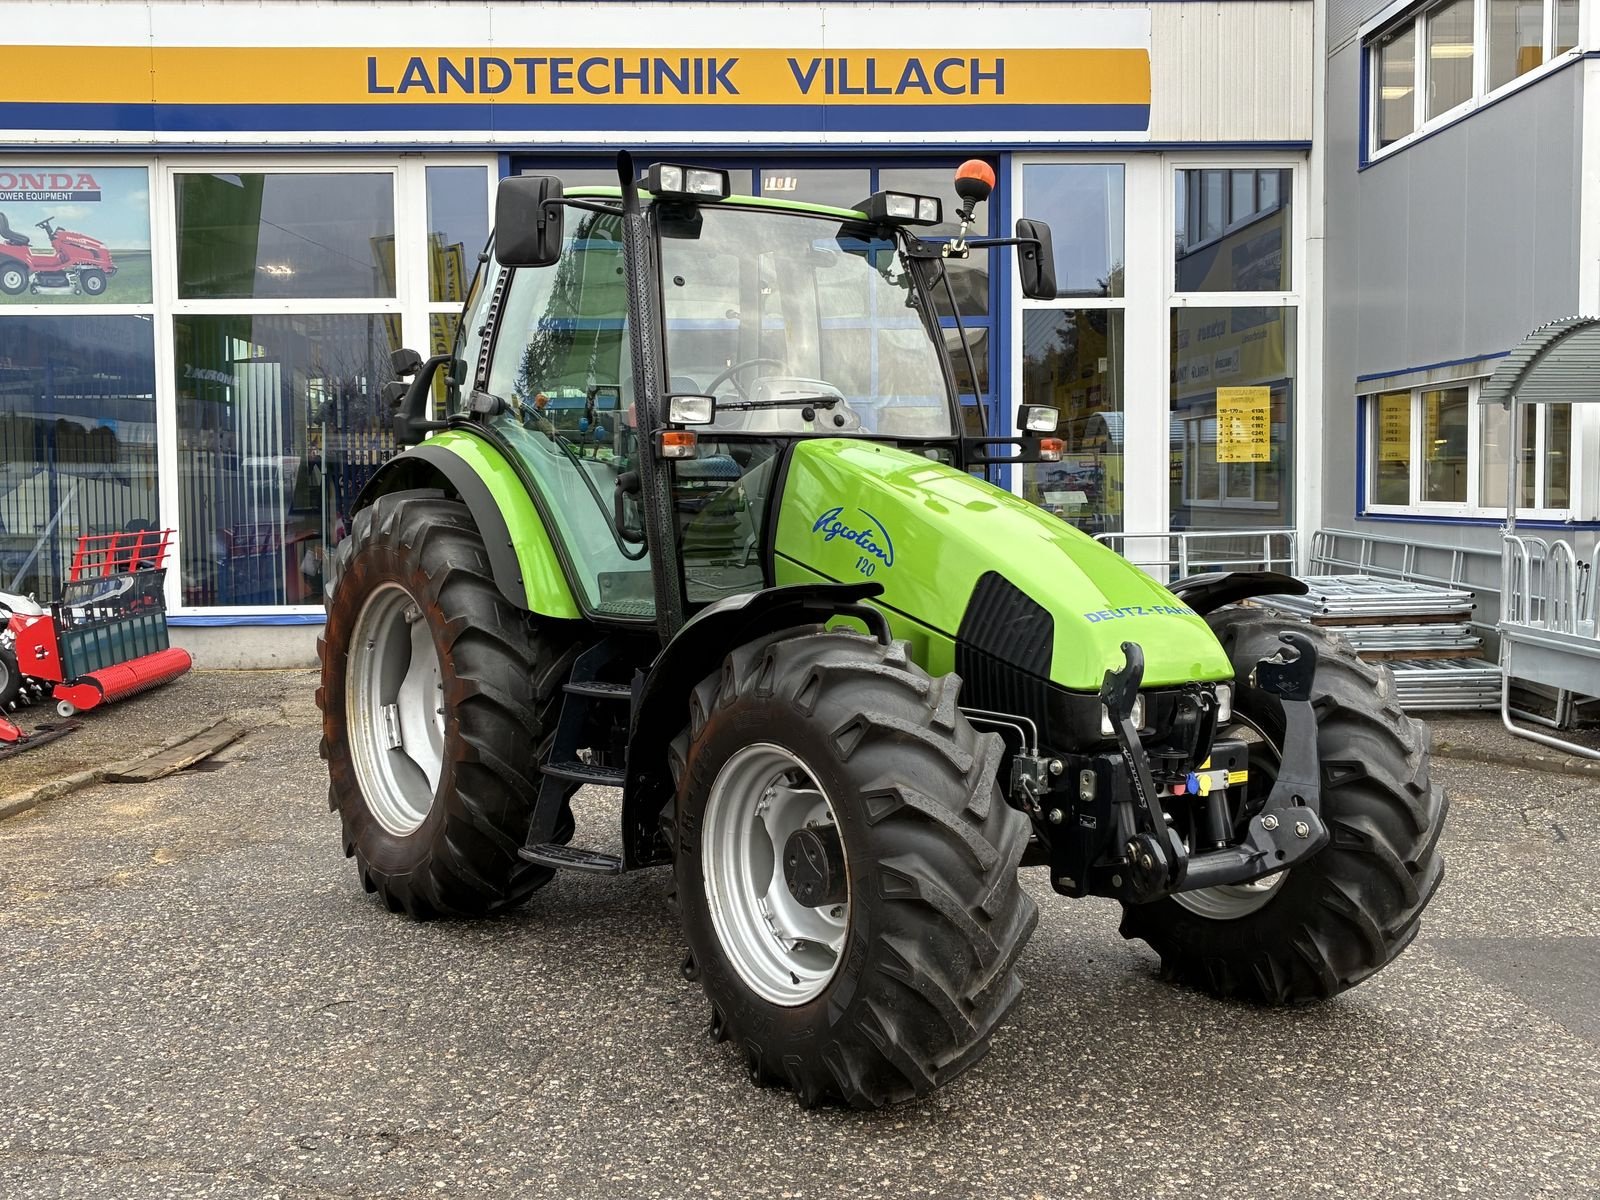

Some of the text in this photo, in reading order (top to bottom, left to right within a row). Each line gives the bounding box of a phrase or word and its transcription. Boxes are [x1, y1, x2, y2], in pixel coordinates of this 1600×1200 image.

[367, 56, 1006, 95] LANDTECHNIK VILLACH
[0, 173, 101, 190] ONDA
[0, 192, 72, 201] OWER EQUIPMENT
[855, 556, 876, 577] 120
